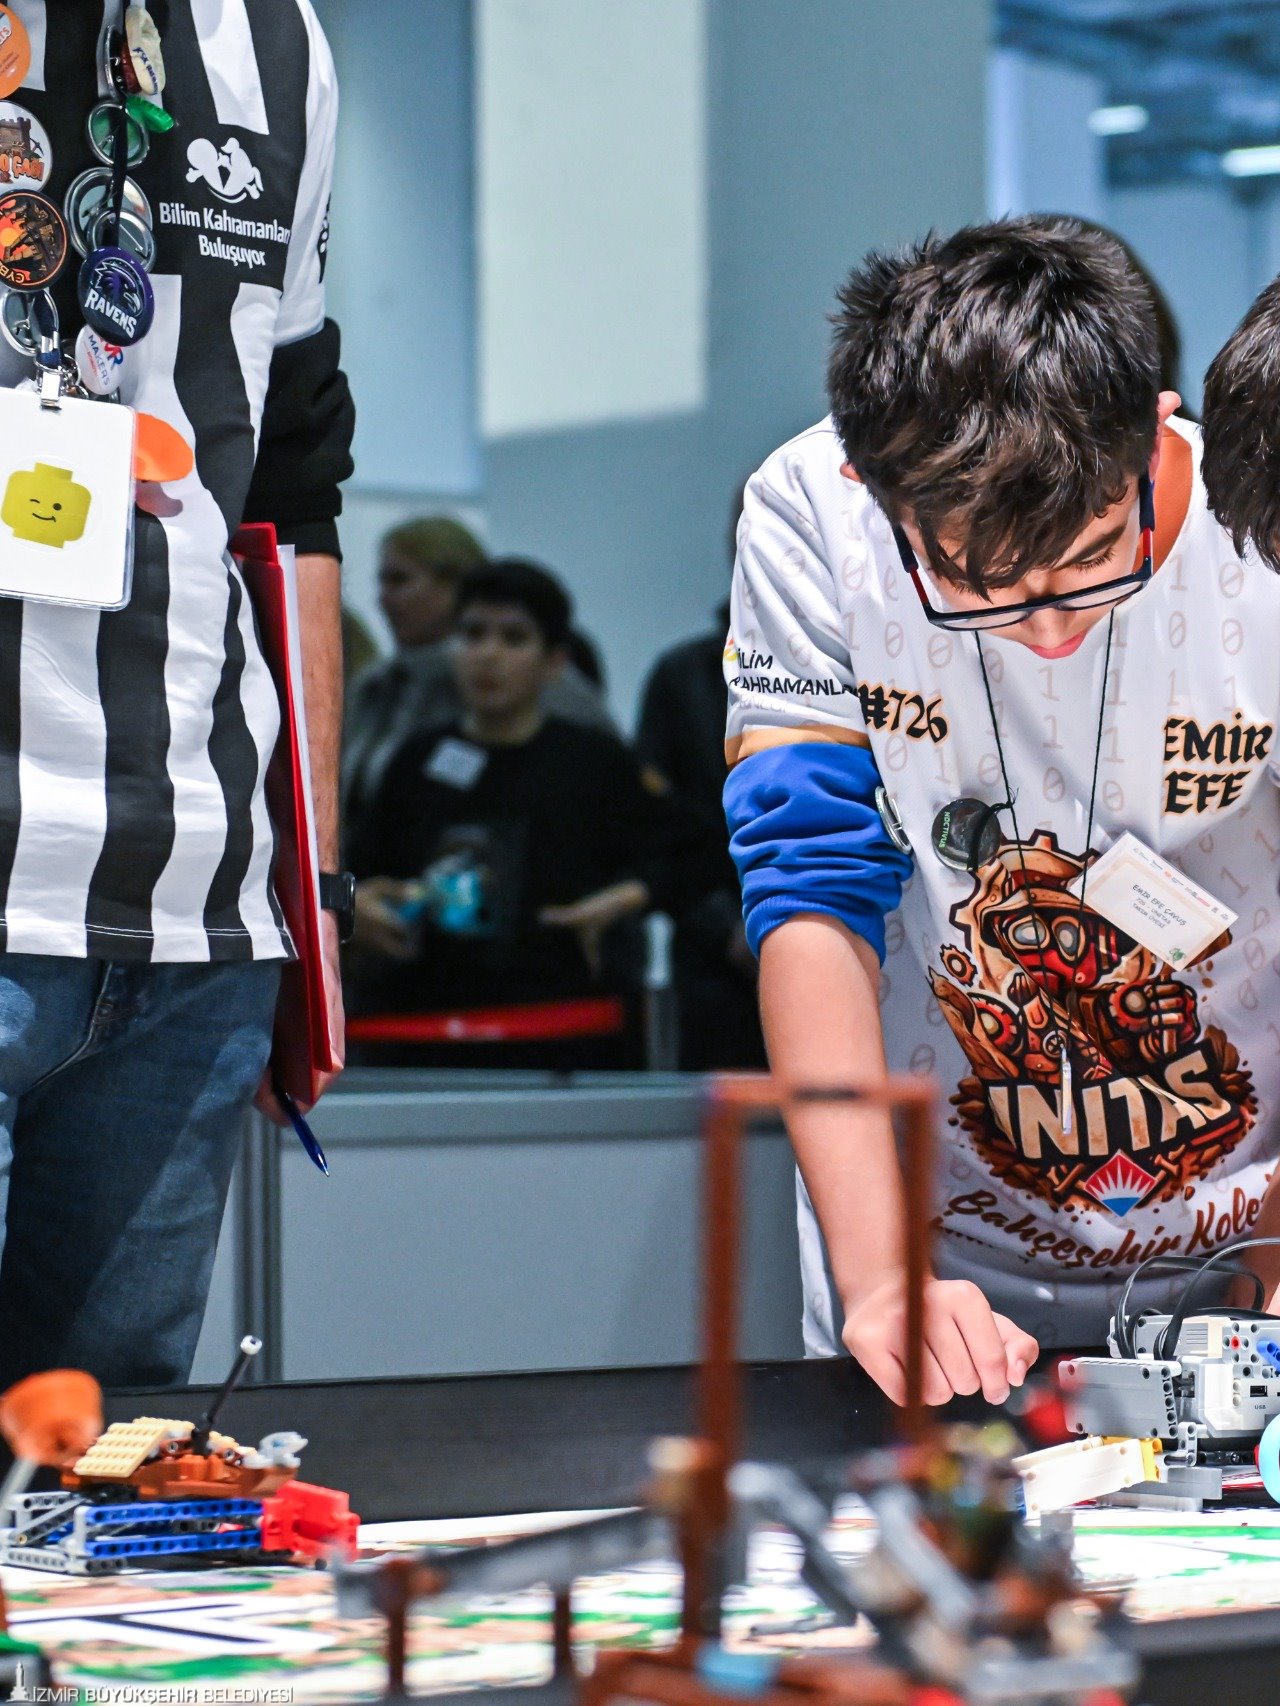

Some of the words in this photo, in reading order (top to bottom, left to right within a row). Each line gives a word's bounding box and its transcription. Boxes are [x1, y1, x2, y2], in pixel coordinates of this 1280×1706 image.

[160, 202, 201, 228] Bilim
[199, 234, 266, 268] Buluşuyor
[85, 290, 137, 339] RAVENS
[857, 683, 948, 744] #726
[1164, 770, 1251, 814] EFE
[1184, 1186, 1265, 1256] Kole
